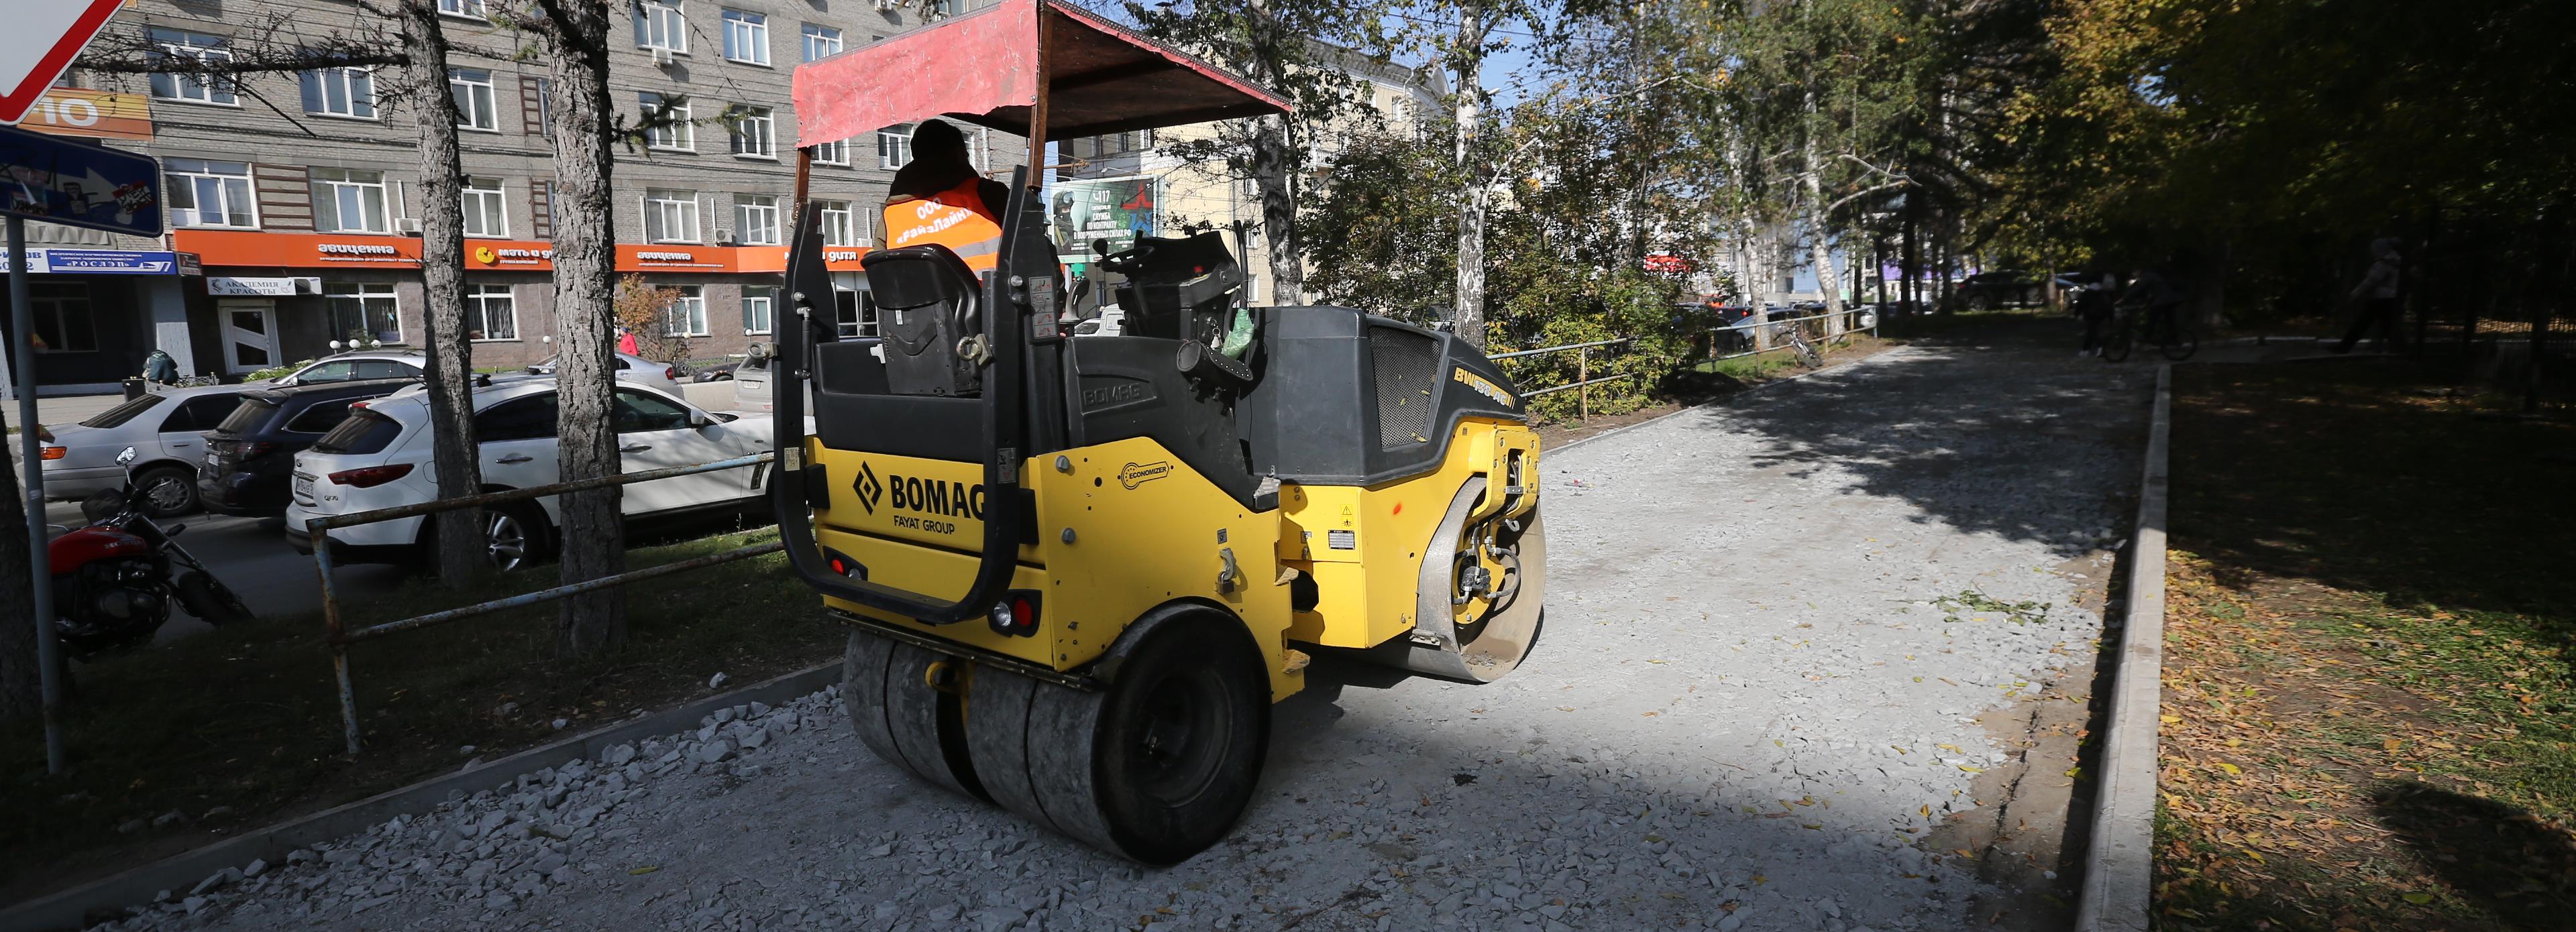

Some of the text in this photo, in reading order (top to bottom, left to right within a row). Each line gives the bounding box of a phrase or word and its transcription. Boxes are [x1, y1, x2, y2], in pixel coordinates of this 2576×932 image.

[916, 197, 943, 220] ООО
[1093, 212, 1111, 221] СЛУЖБА
[896, 207, 973, 244] «РайзЛайн»
[1087, 221, 1118, 230] ПО КОНТРАКТУ
[1109, 229, 1124, 237] СИЛАХ
[1124, 229, 1132, 237] РФ
[1454, 367, 1475, 387] BW
[1083, 383, 1142, 406] BOMAG
[1129, 467, 1167, 479] ECONOMIZER
[889, 474, 985, 522] BOMAG
[894, 515, 955, 535] FAYAT GROUP
